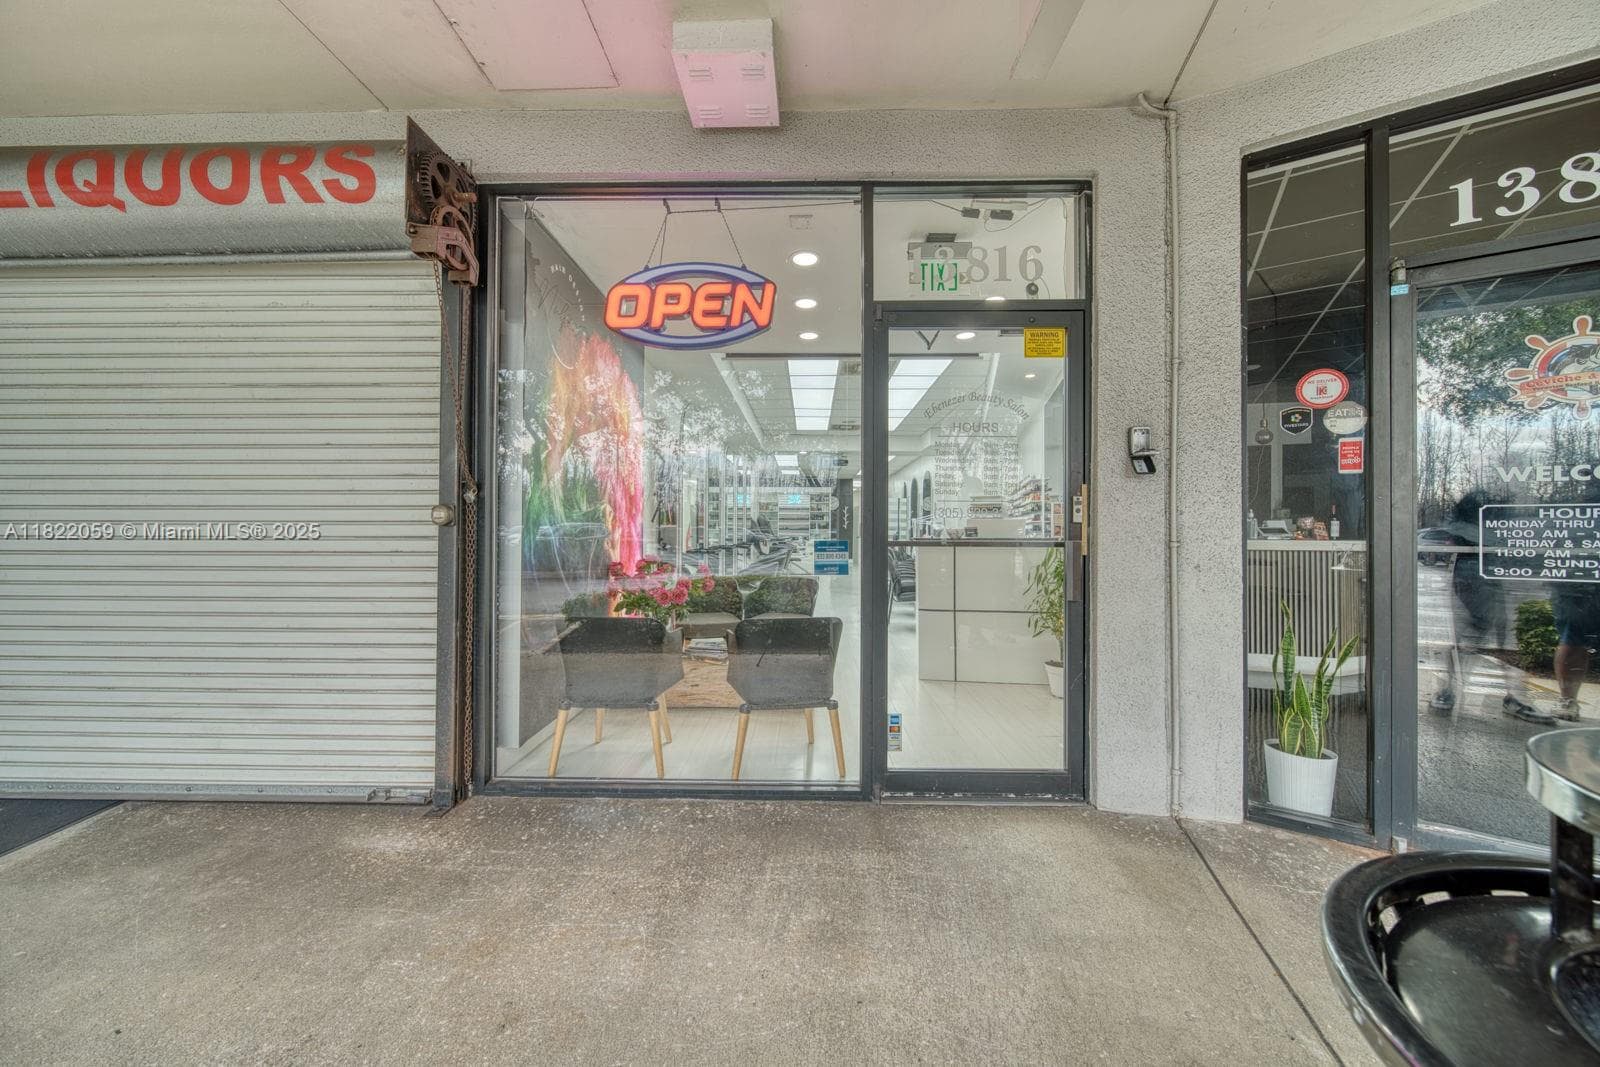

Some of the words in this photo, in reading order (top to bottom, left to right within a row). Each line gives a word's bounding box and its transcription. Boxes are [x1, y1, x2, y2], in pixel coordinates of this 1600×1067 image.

[1449, 152, 1600, 227] 138
[604, 281, 777, 331] OPEN
[1003, 398, 1030, 420] Salon
[952, 422, 999, 433] HOURS
[1485, 520, 1546, 528] MONDAY
[1554, 520, 1595, 528] THRU
[1494, 529, 1535, 538] 11:00
[1541, 530, 1569, 538] AM
[1507, 540, 1557, 548] FRIDAY
[1563, 540, 1574, 548] &
[1495, 549, 1537, 558] 11:00
[1543, 550, 1571, 558] AM
[1543, 559, 1600, 569] SUND
[1494, 567, 1533, 576] 9:00
[1539, 568, 1567, 577] AM
